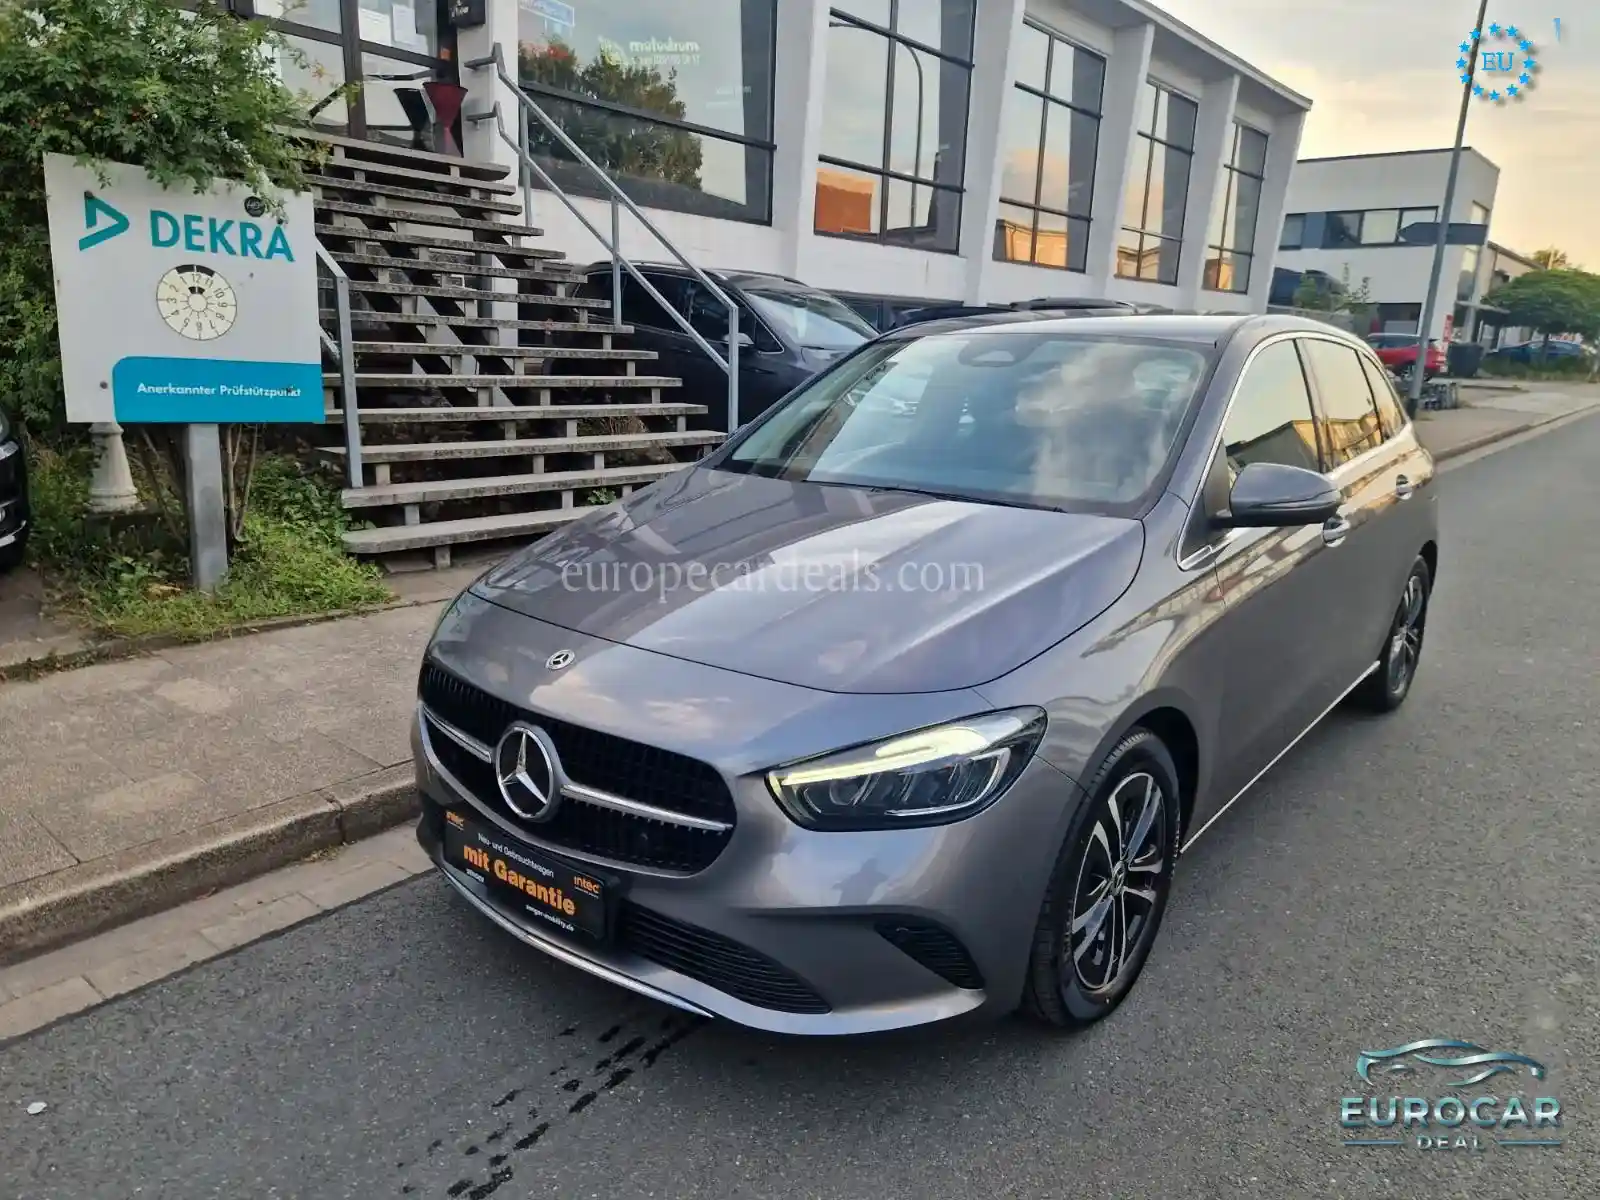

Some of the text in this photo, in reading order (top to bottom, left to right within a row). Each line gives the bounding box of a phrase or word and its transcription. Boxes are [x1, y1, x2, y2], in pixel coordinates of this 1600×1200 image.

[150, 209, 296, 263] DEKRA
[137, 382, 301, 399] Anerkannter Prüfstützpunkt
[463, 844, 577, 916] mit Garantie
